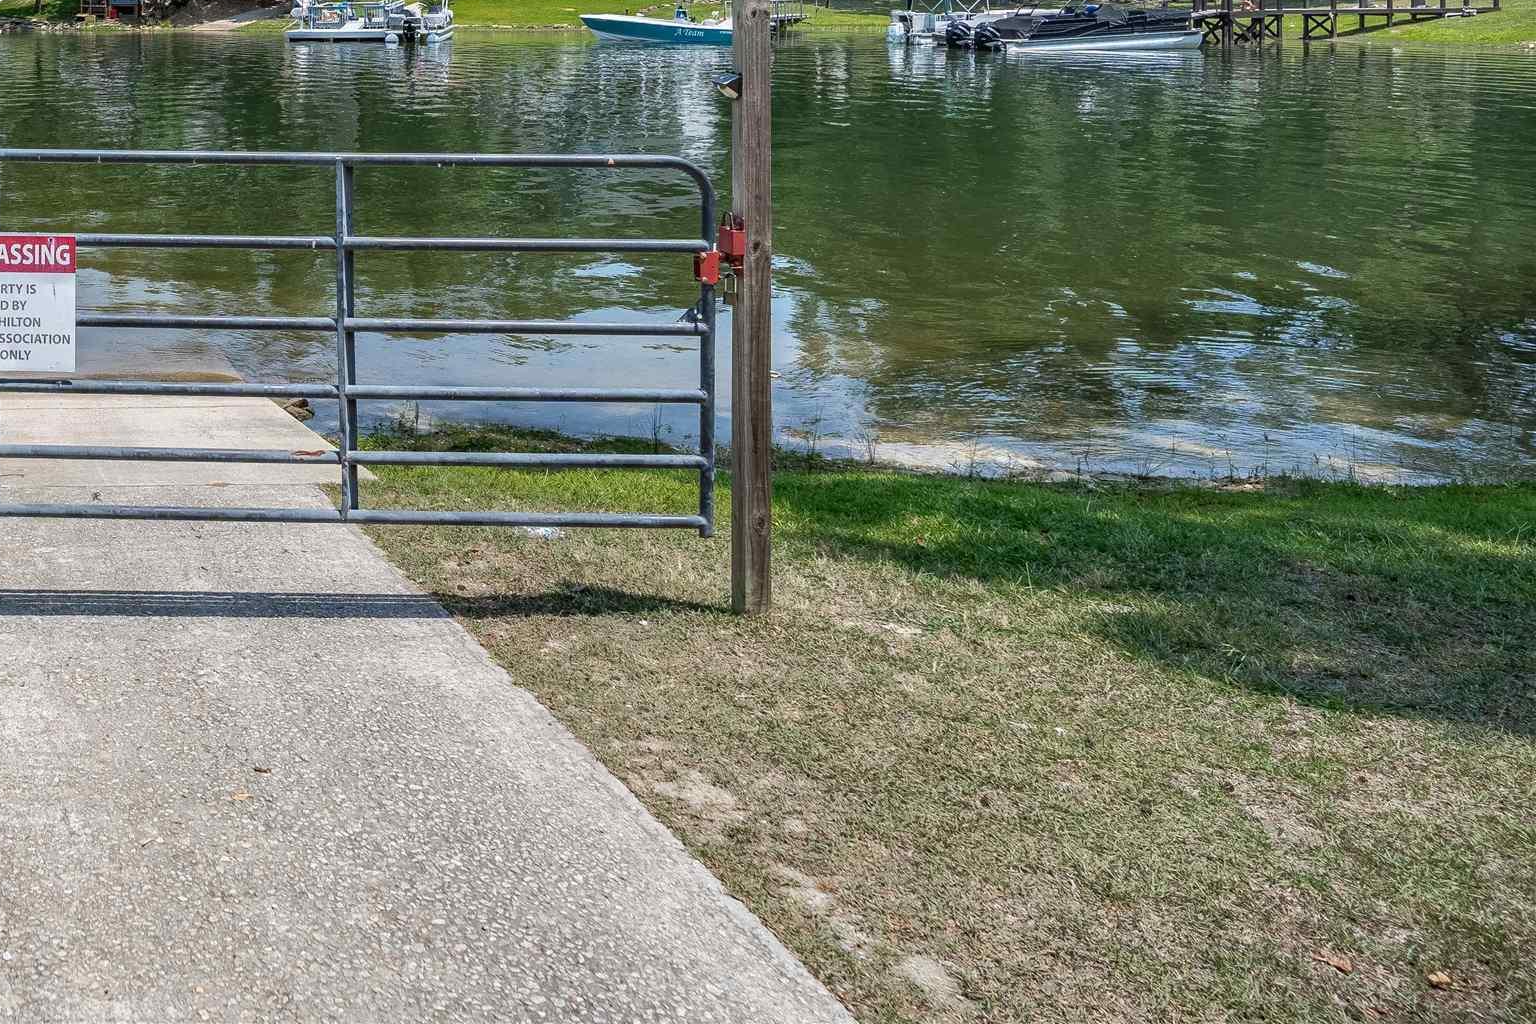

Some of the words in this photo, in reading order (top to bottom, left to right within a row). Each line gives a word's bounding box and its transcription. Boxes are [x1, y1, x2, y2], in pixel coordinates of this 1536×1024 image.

[26, 283, 37, 295] IS
[12, 299, 27, 311] BY
[0, 349, 32, 361] ONLY
